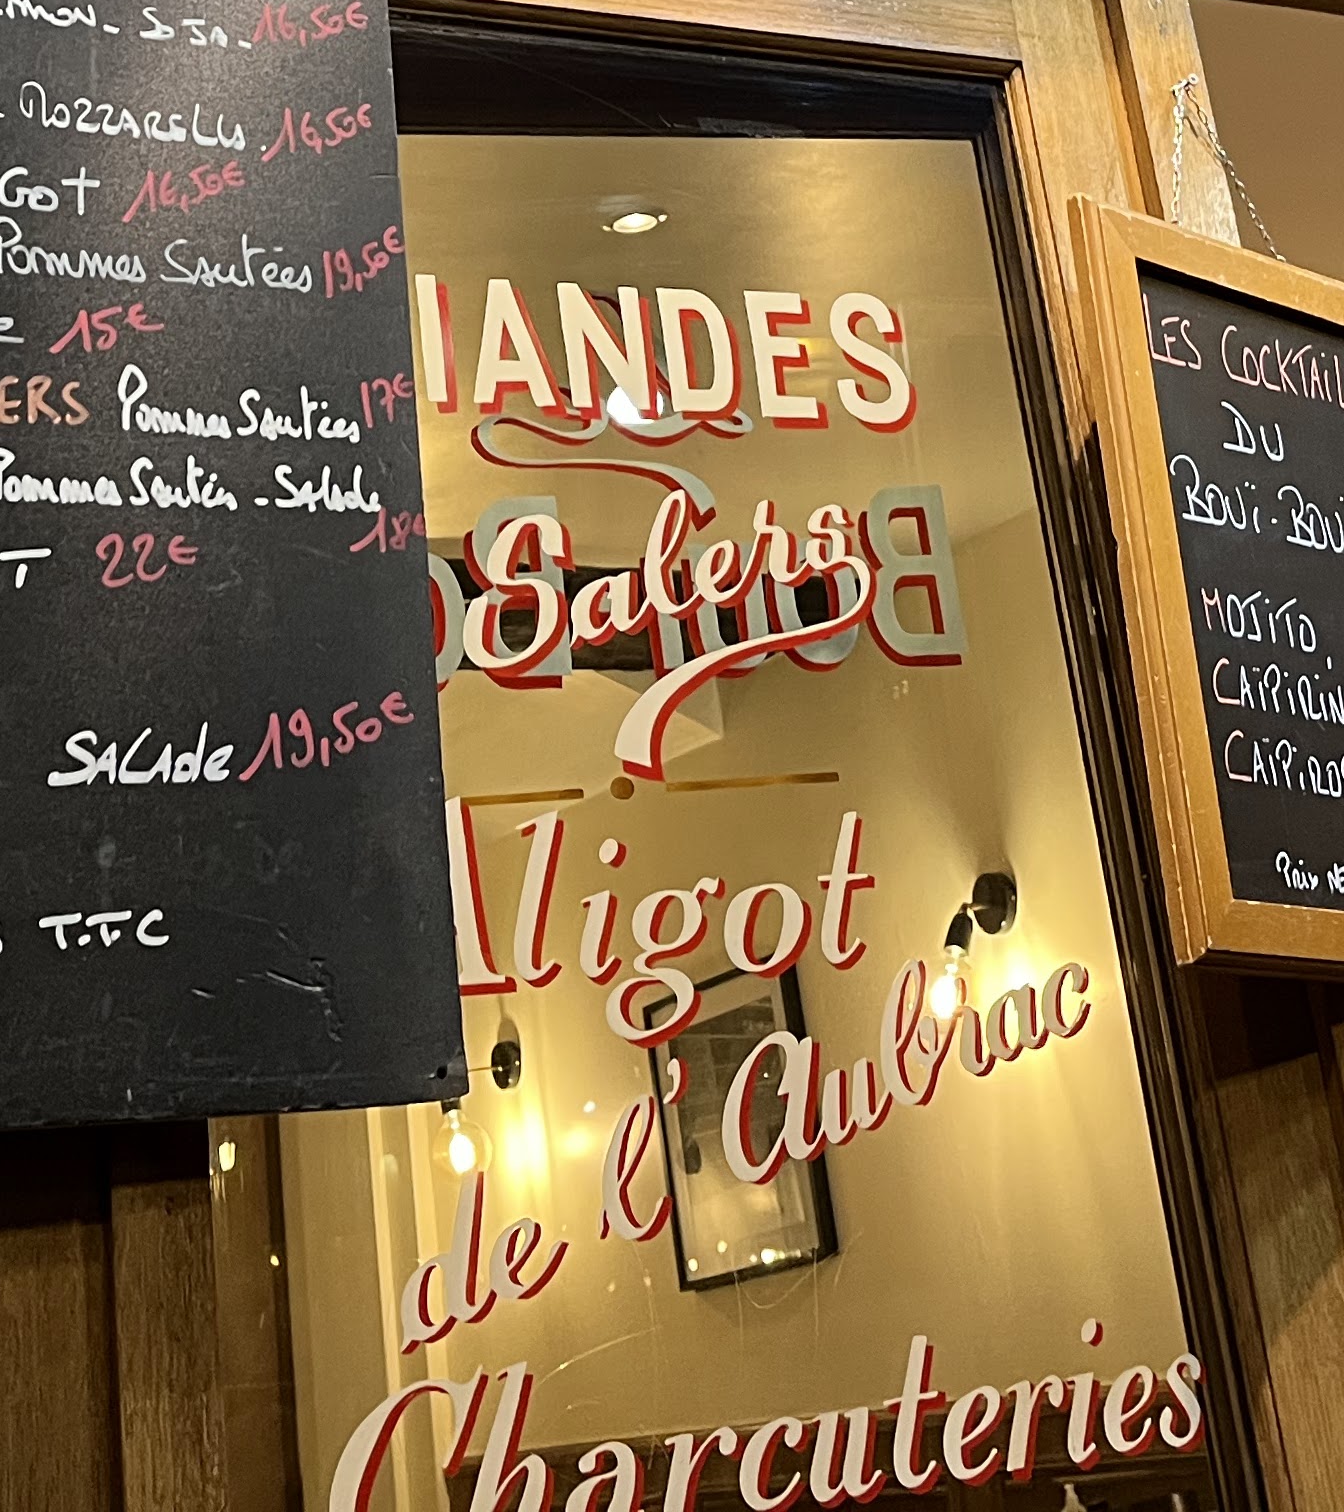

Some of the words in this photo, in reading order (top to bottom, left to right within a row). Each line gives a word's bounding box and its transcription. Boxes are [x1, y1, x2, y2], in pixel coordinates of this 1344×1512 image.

[49, 304, 164, 355] 15€
[415, 274, 916, 433] IANDES
[1143, 293, 1201, 370] LES
[1221, 401, 1284, 461] DU
[95, 532, 199, 589] 22€
[464, 489, 874, 781] Salers
[239, 691, 414, 781] 19,50€
[401, 1172, 569, 1354] de
[329, 1318, 1206, 1512] Charcuteries
